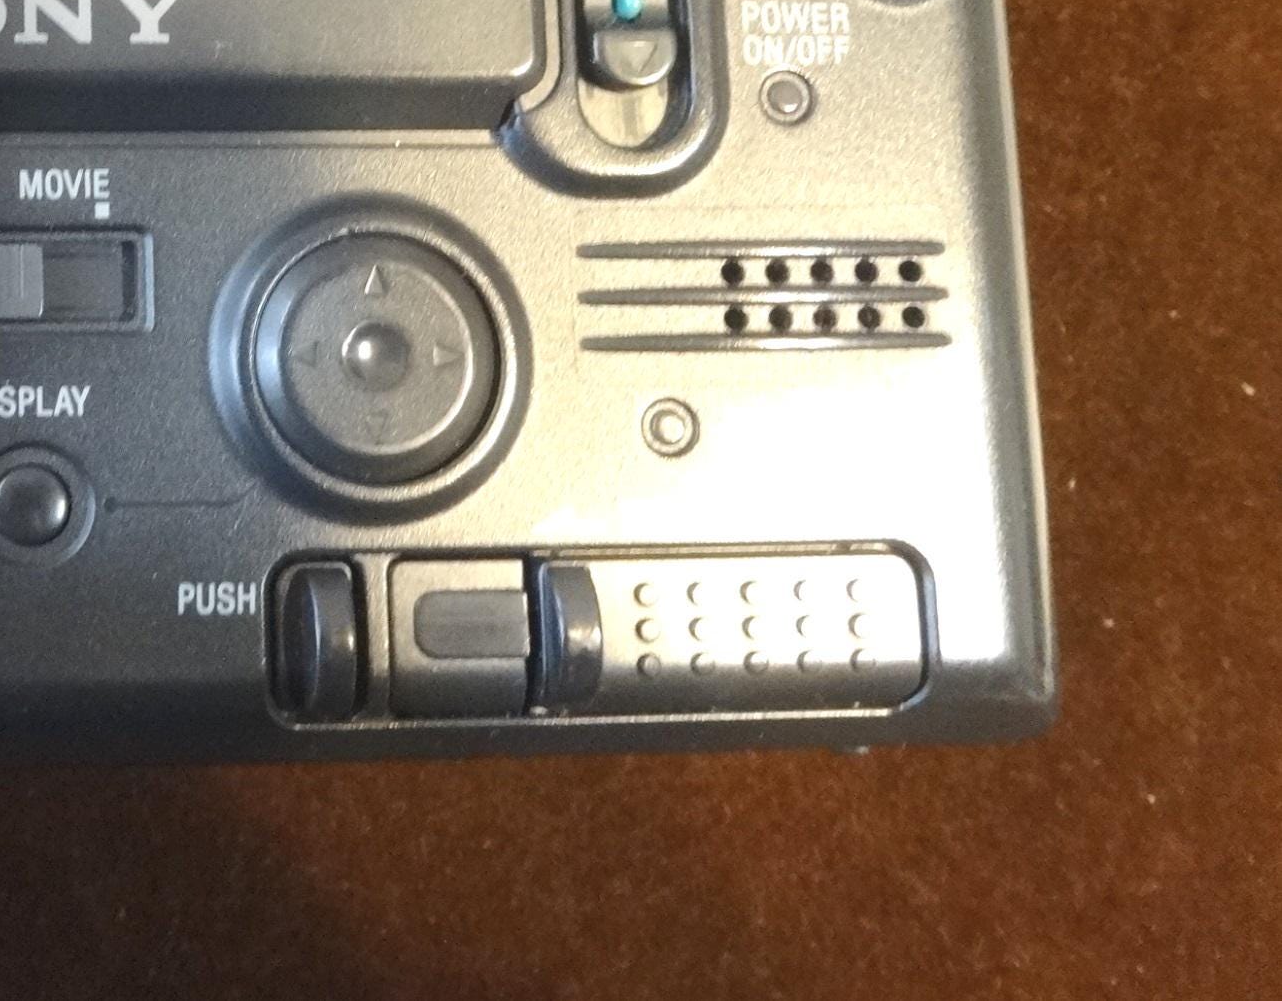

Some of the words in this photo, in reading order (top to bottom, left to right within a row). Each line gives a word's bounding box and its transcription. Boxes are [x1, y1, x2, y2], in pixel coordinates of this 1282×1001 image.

[740, 0, 850, 33] POWER
[742, 34, 850, 66] ON/OFF
[18, 168, 110, 200] MOVIE
[177, 581, 257, 616] PUSH
